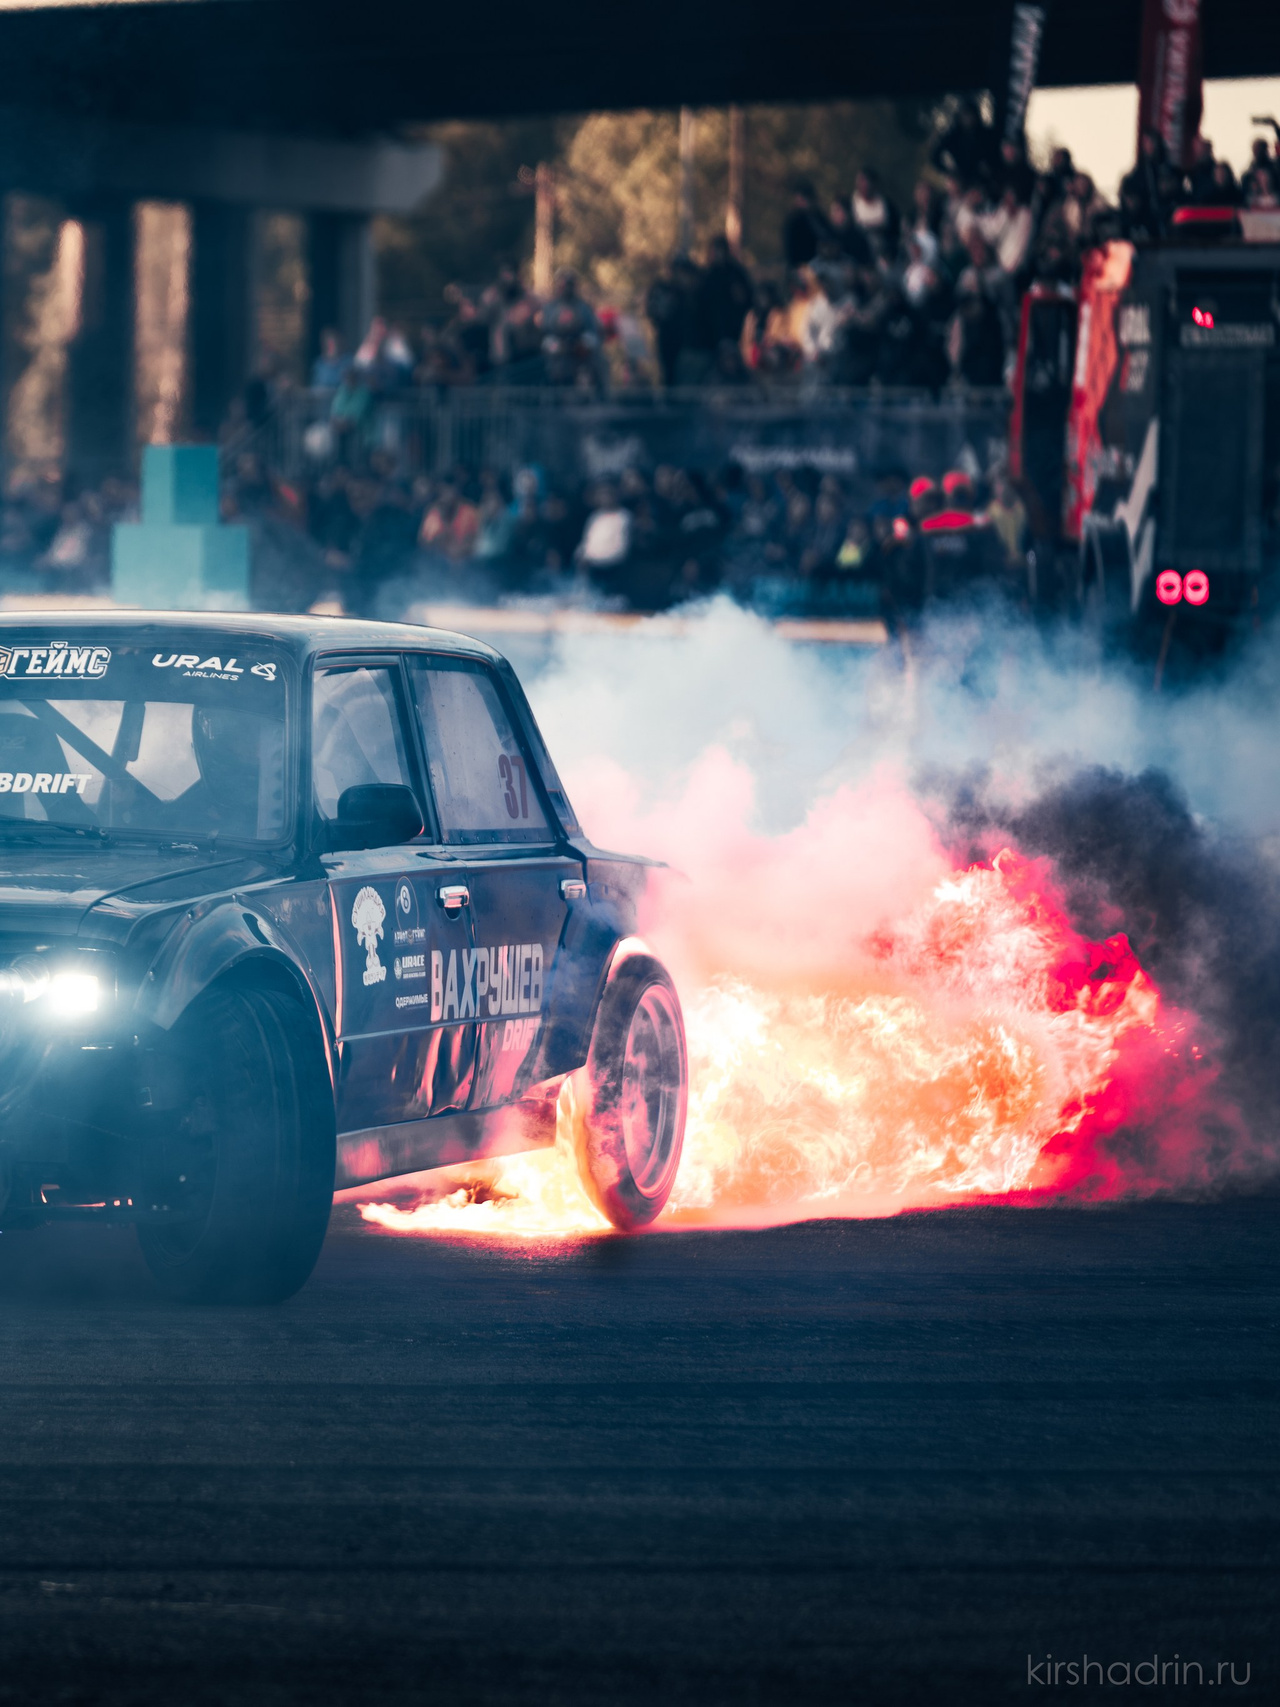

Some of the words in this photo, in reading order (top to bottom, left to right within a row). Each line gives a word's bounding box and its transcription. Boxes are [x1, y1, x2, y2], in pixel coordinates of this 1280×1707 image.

[7, 643, 110, 677] ГЕЙМС
[151, 653, 245, 673] URAL
[182, 670, 240, 681] AIRLINES
[498, 754, 528, 819] 37
[430, 943, 544, 1024] ВАХРУШЕВ
